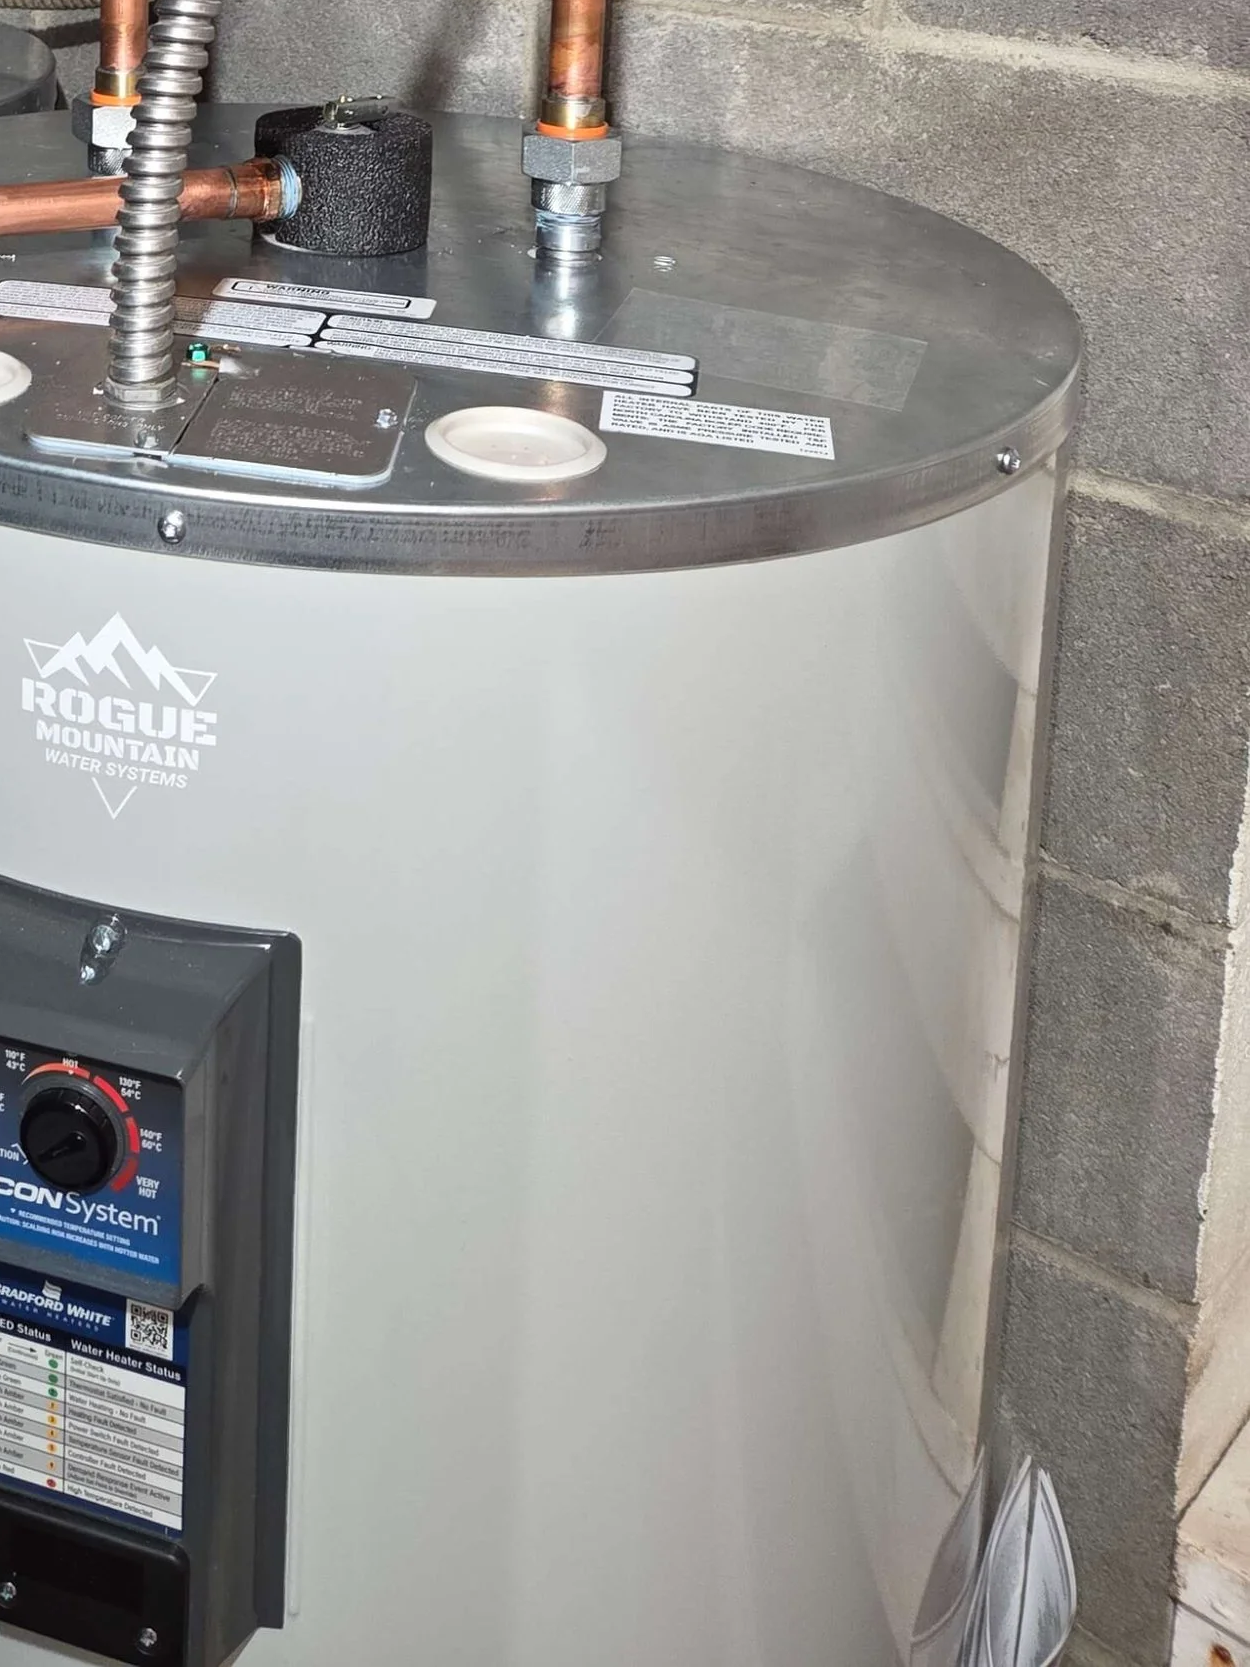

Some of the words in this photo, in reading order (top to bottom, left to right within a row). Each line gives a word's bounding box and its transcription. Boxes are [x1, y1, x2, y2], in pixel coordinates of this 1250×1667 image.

[21, 677, 217, 746] ROGUE
[36, 719, 199, 771] MOUNTAIN
[45, 747, 102, 774] WATER
[105, 761, 188, 789] SYSTEMS
[136, 1175, 160, 1190] VERY
[138, 1186, 157, 1198] HOT
[65, 1191, 159, 1236] System
[17, 1323, 52, 1342] Status
[67, 1303, 112, 1327] WHITE
[71, 1338, 104, 1357] Water
[105, 1349, 143, 1369] Heater
[145, 1361, 181, 1381] Status
